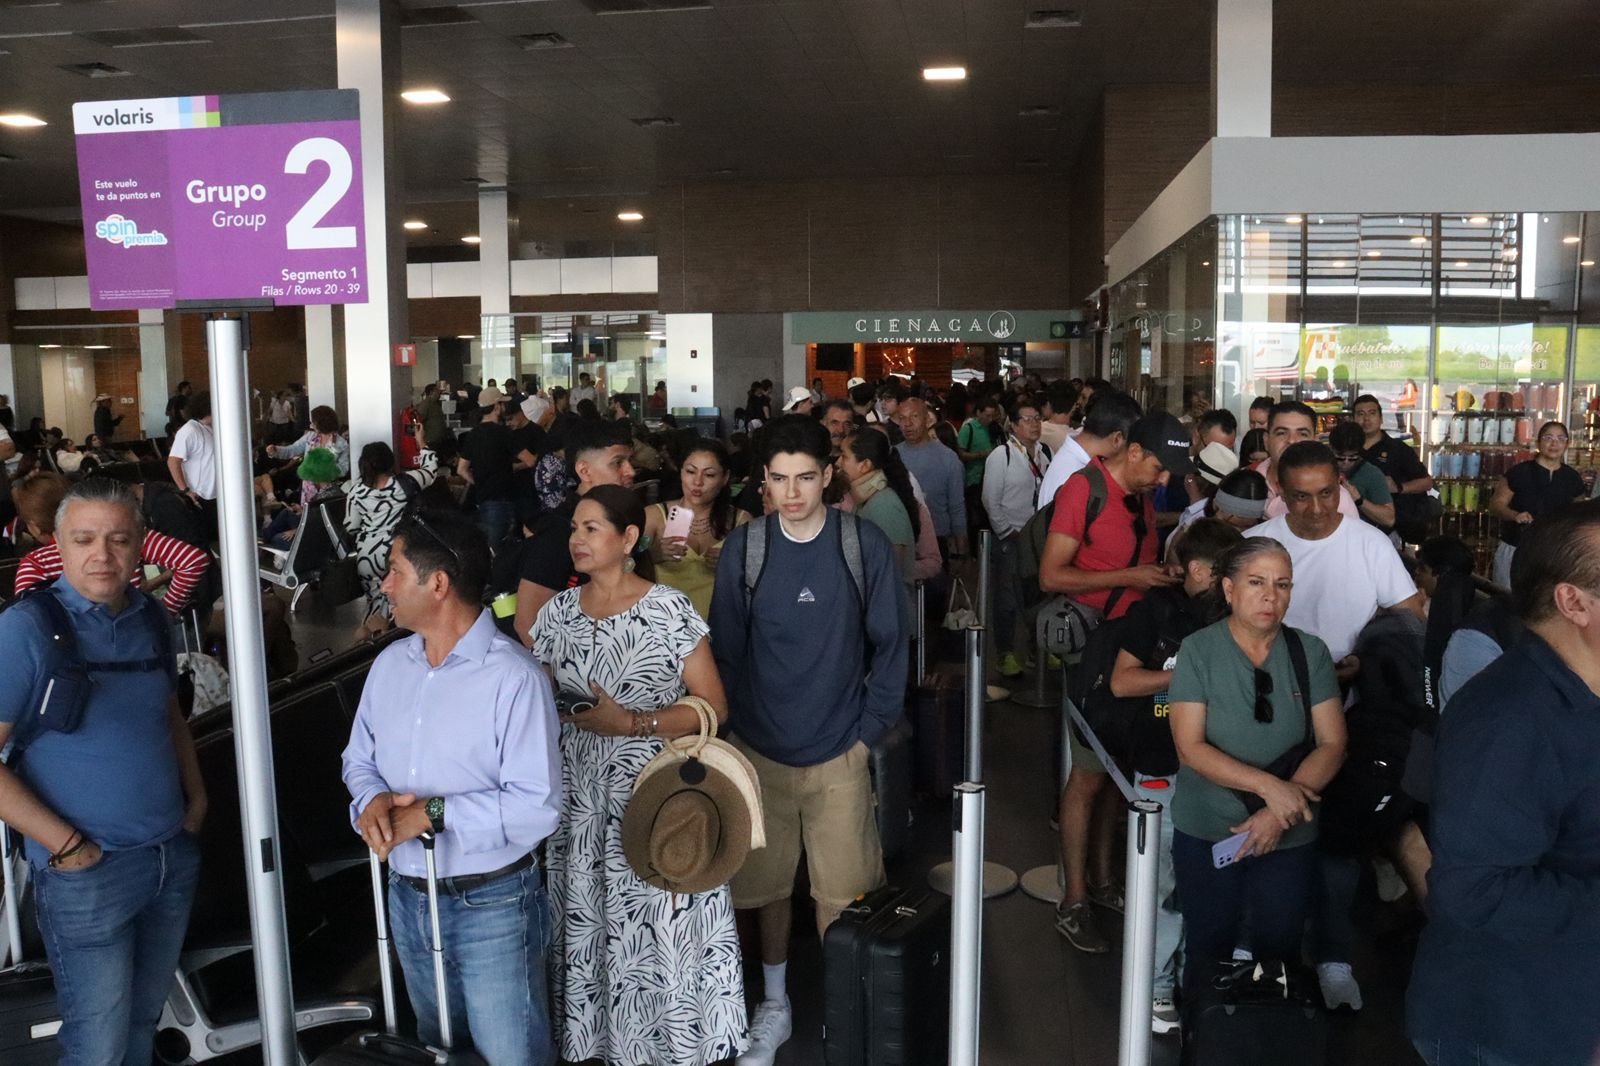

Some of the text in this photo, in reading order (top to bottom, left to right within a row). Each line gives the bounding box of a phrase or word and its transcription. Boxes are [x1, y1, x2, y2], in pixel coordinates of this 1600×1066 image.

[93, 108, 154, 126] volaris
[95, 179, 138, 188] Este vuelo
[96, 193, 106, 201] te
[107, 192, 118, 201] da
[119, 192, 148, 202] puntos
[186, 180, 267, 208] Grupo
[284, 137, 357, 250] 2
[97, 219, 135, 239] spin
[212, 210, 267, 231] Group
[281, 267, 357, 283] Segmento 1
[261, 285, 284, 297] Filas
[286, 285, 292, 296] /
[294, 284, 322, 296] Rows
[324, 284, 338, 295] 20
[347, 283, 360, 294] 39
[877, 336, 961, 344] COCINA MEXICANA
